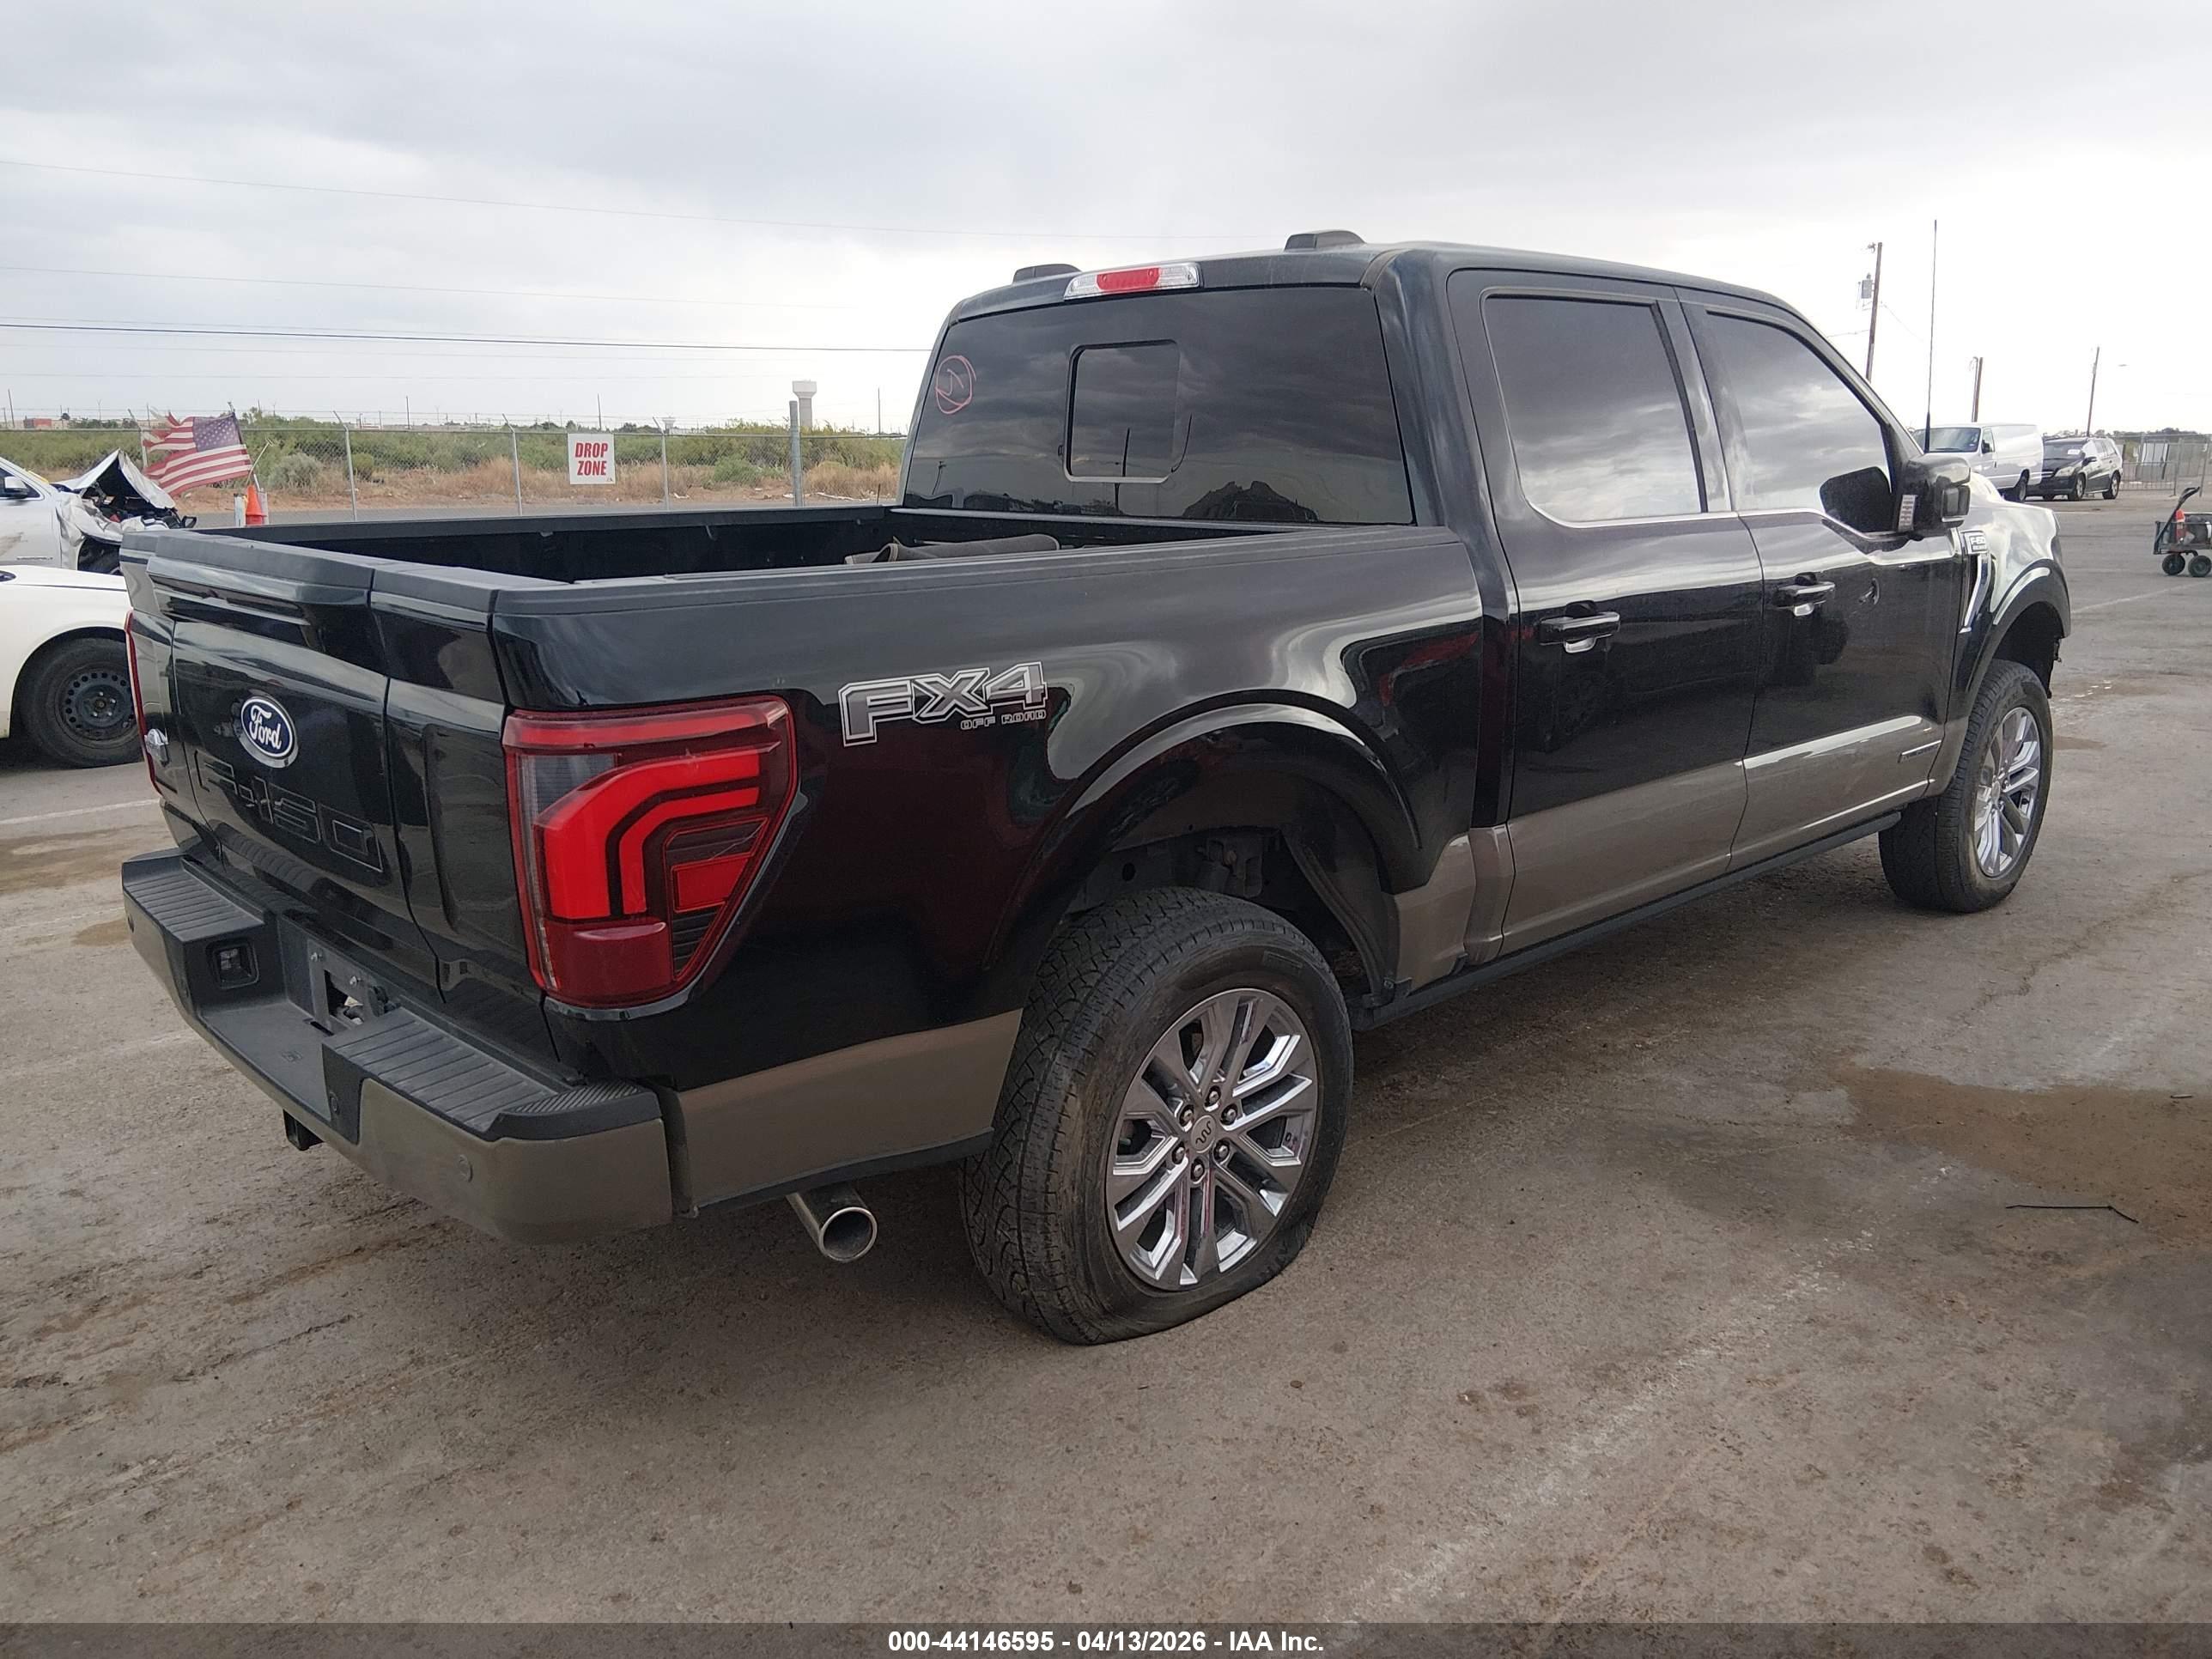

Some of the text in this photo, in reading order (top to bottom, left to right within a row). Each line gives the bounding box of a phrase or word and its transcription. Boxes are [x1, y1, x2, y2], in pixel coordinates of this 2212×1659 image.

[575, 442, 609, 458] DROP
[577, 460, 607, 476] ZONE
[838, 661, 1048, 747] FX4
[960, 709, 1047, 730] OFF ROAD
[249, 704, 283, 750] Ford
[194, 749, 384, 873] F-150
